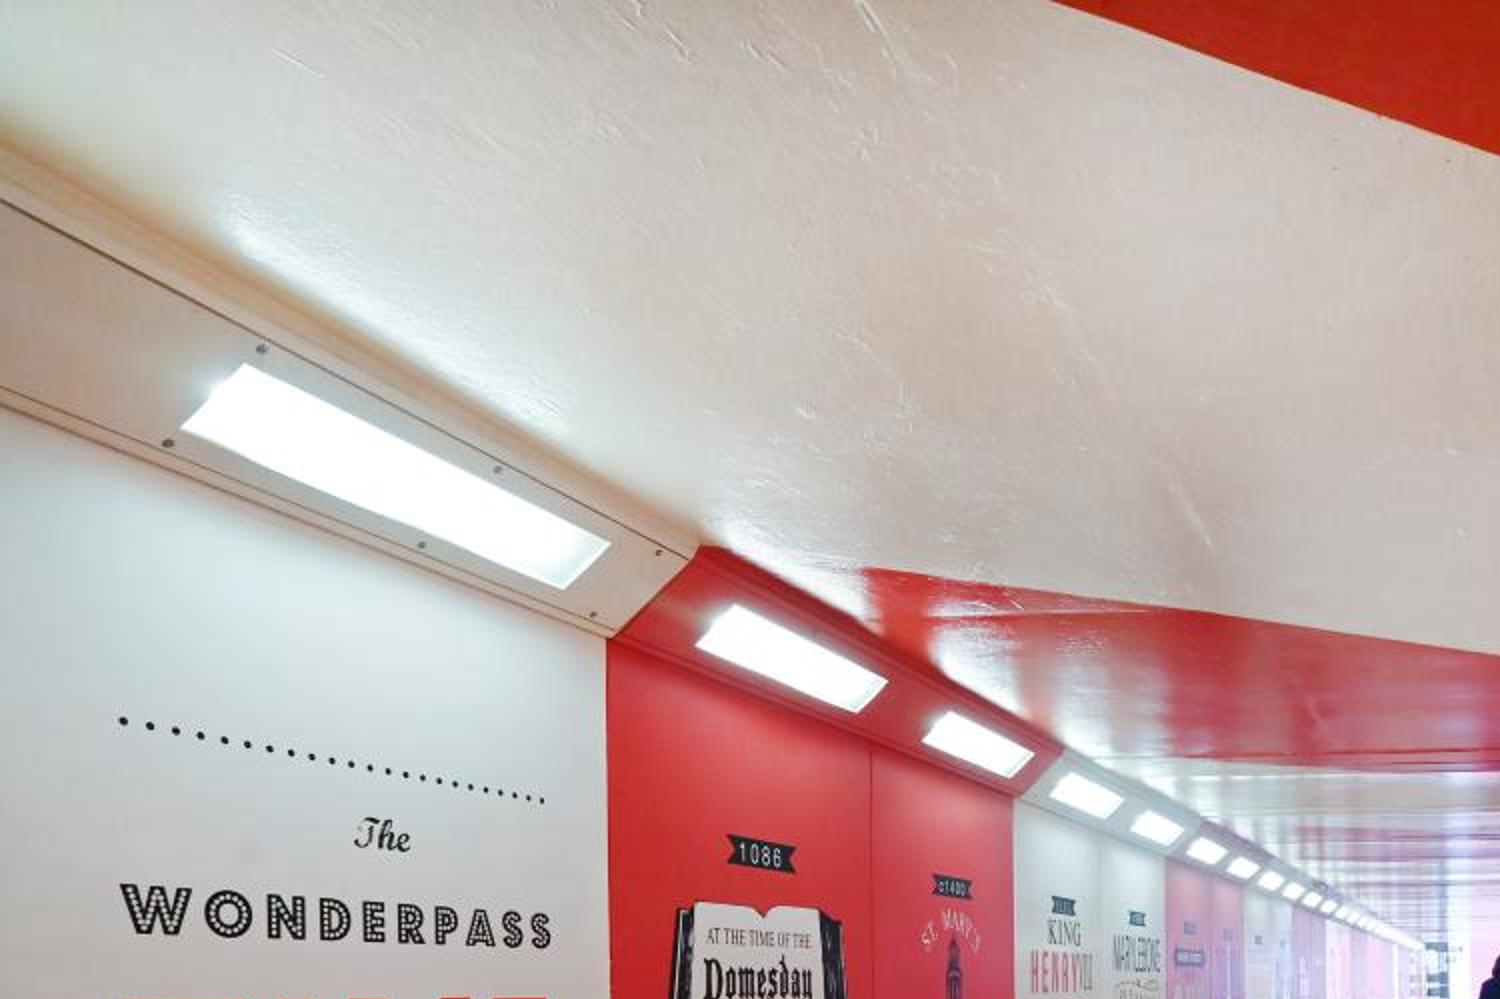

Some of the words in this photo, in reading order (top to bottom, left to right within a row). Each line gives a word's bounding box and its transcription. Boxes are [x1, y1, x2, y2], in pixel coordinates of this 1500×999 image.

[353, 816, 411, 853] The
[739, 841, 782, 868] 1086
[119, 883, 552, 950] WONDERPASS
[1047, 919, 1081, 946] KING
[706, 928, 721, 945] AT
[723, 928, 748, 946] THE
[749, 929, 775, 947] TIME
[777, 931, 791, 948] OF
[1031, 949, 1079, 993] HENRY
